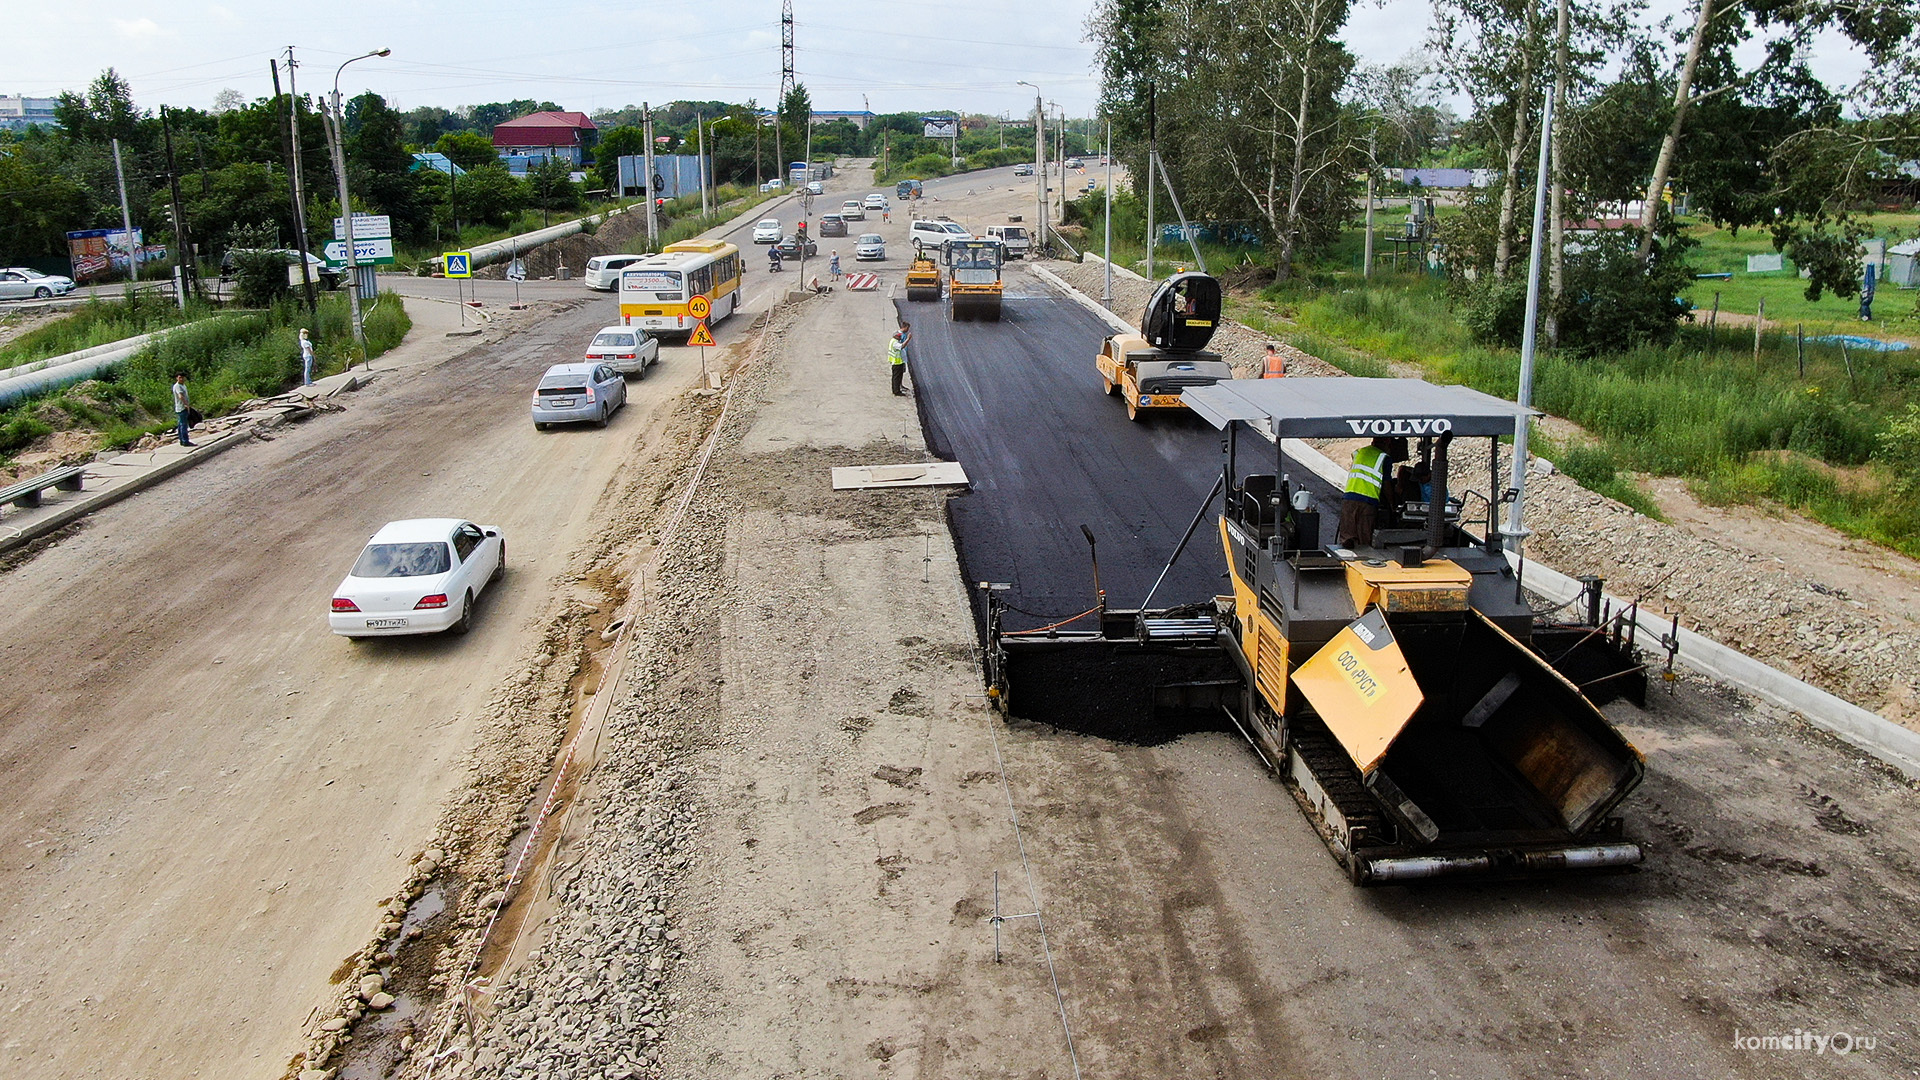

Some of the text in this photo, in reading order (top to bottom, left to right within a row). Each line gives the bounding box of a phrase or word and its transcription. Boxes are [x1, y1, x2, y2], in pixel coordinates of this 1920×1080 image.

[339, 247, 376, 258] ПРУС
[692, 302, 706, 313] 40
[1346, 418, 1452, 435] VOLVO
[1337, 650, 1358, 672] ООО
